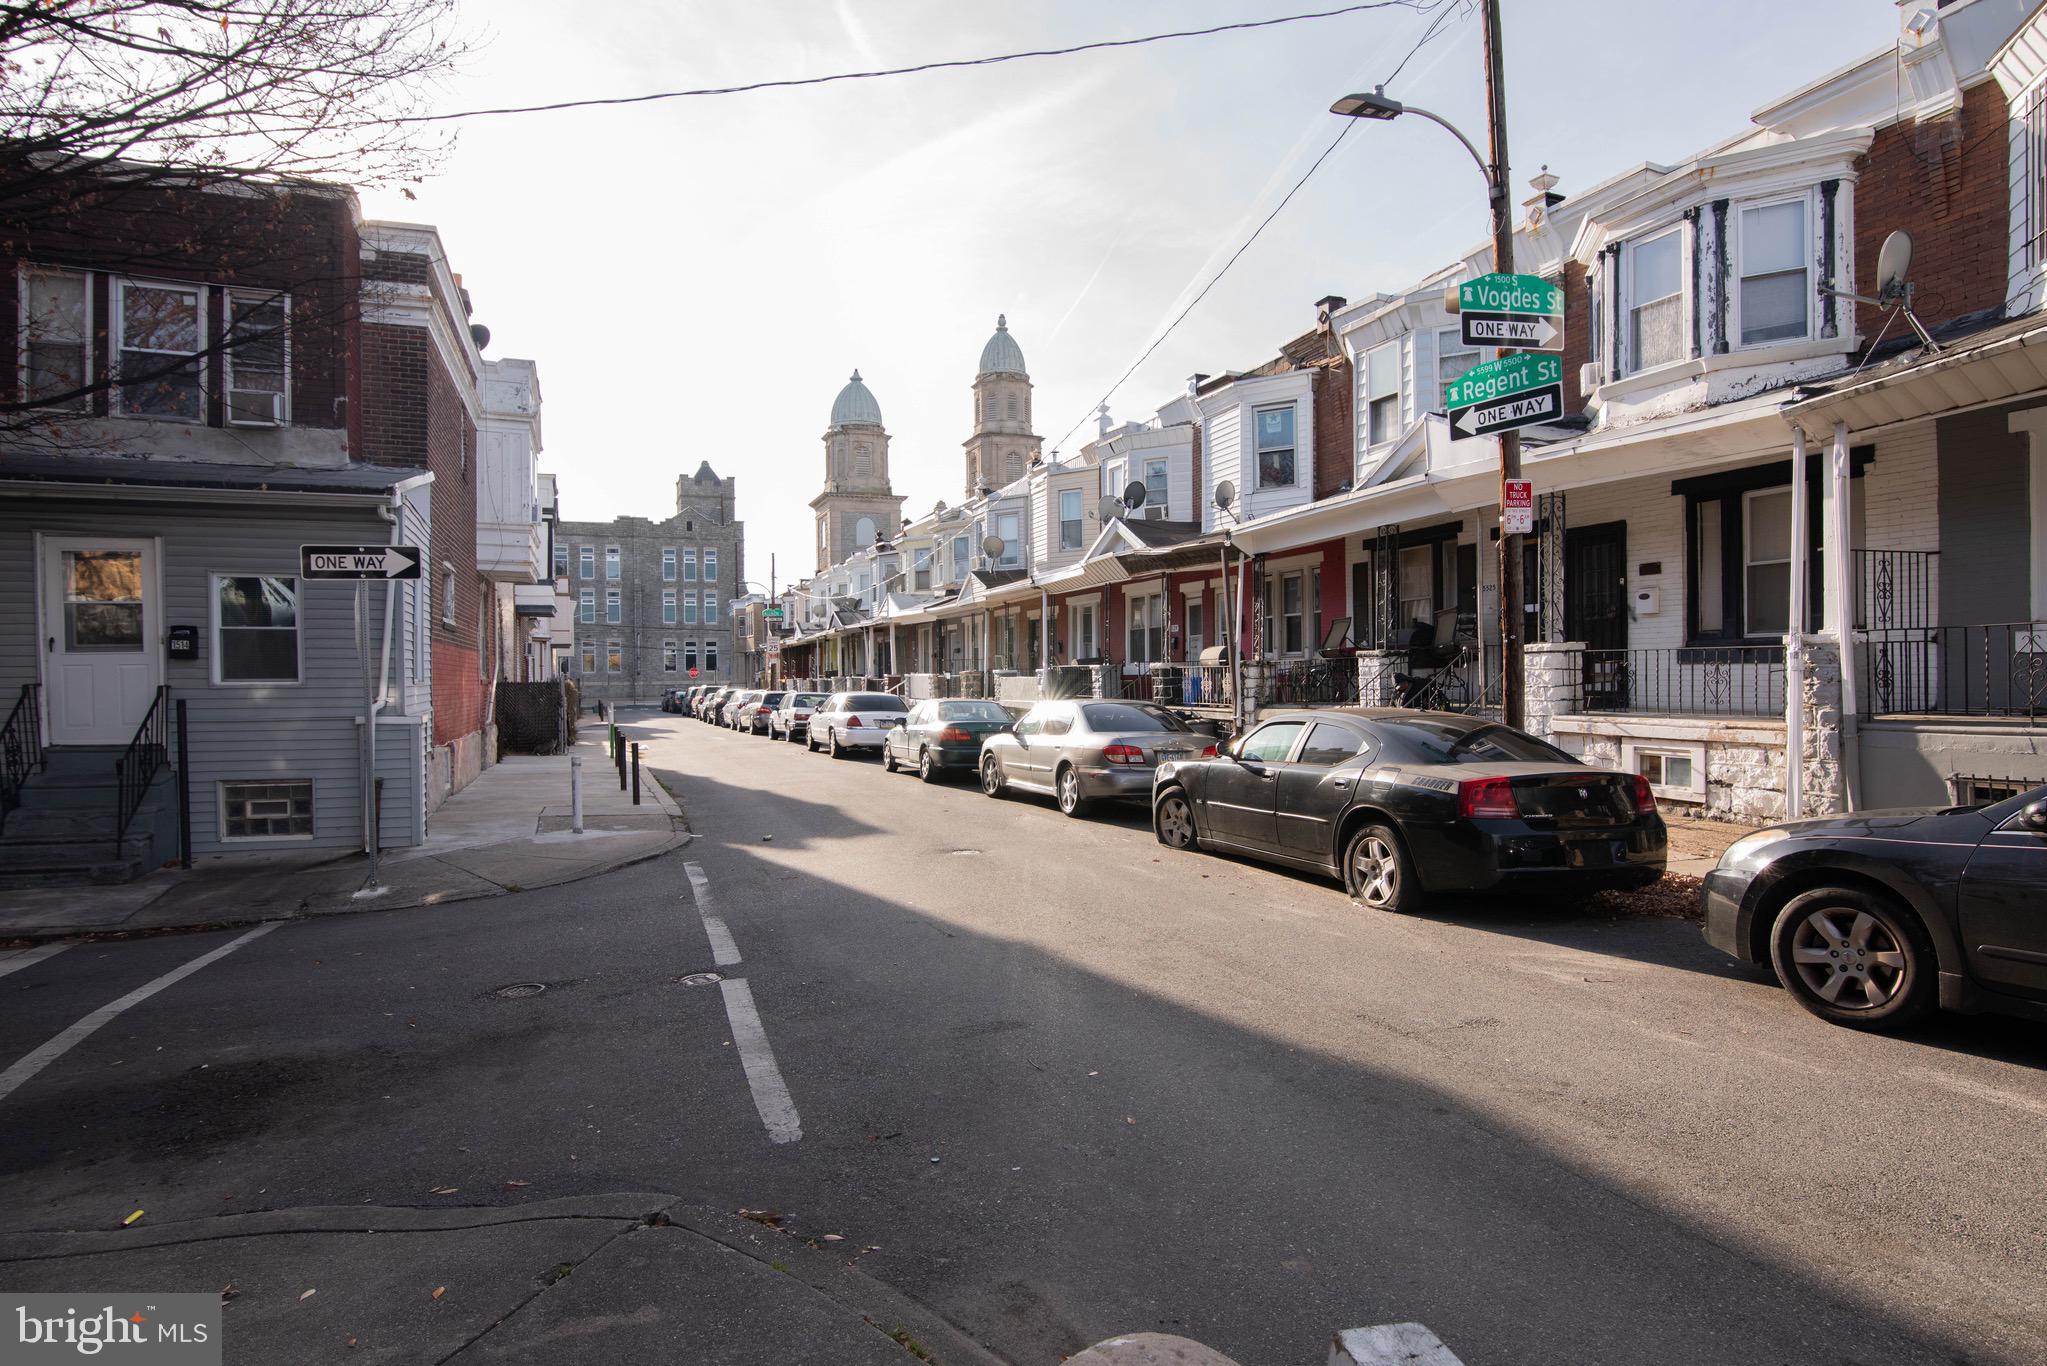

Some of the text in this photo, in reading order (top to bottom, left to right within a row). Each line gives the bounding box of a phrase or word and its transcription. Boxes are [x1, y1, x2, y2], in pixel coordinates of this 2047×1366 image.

[1494, 275, 1518, 286] 1500 S
[1477, 285, 1562, 311] Vogdes St
[1475, 321, 1536, 338] ONE WAY
[1476, 356, 1523, 376] 5599 W 5500
[1463, 359, 1558, 401] Regent St
[1477, 396, 1546, 426] ONE WAY
[1513, 483, 1523, 491] NO
[1509, 491, 1528, 499] TRUCK
[1506, 499, 1531, 507] PARKING
[314, 556, 386, 569] ONE WAY
[768, 644, 779, 652] 25
[1411, 776, 1455, 791] CHARGER
